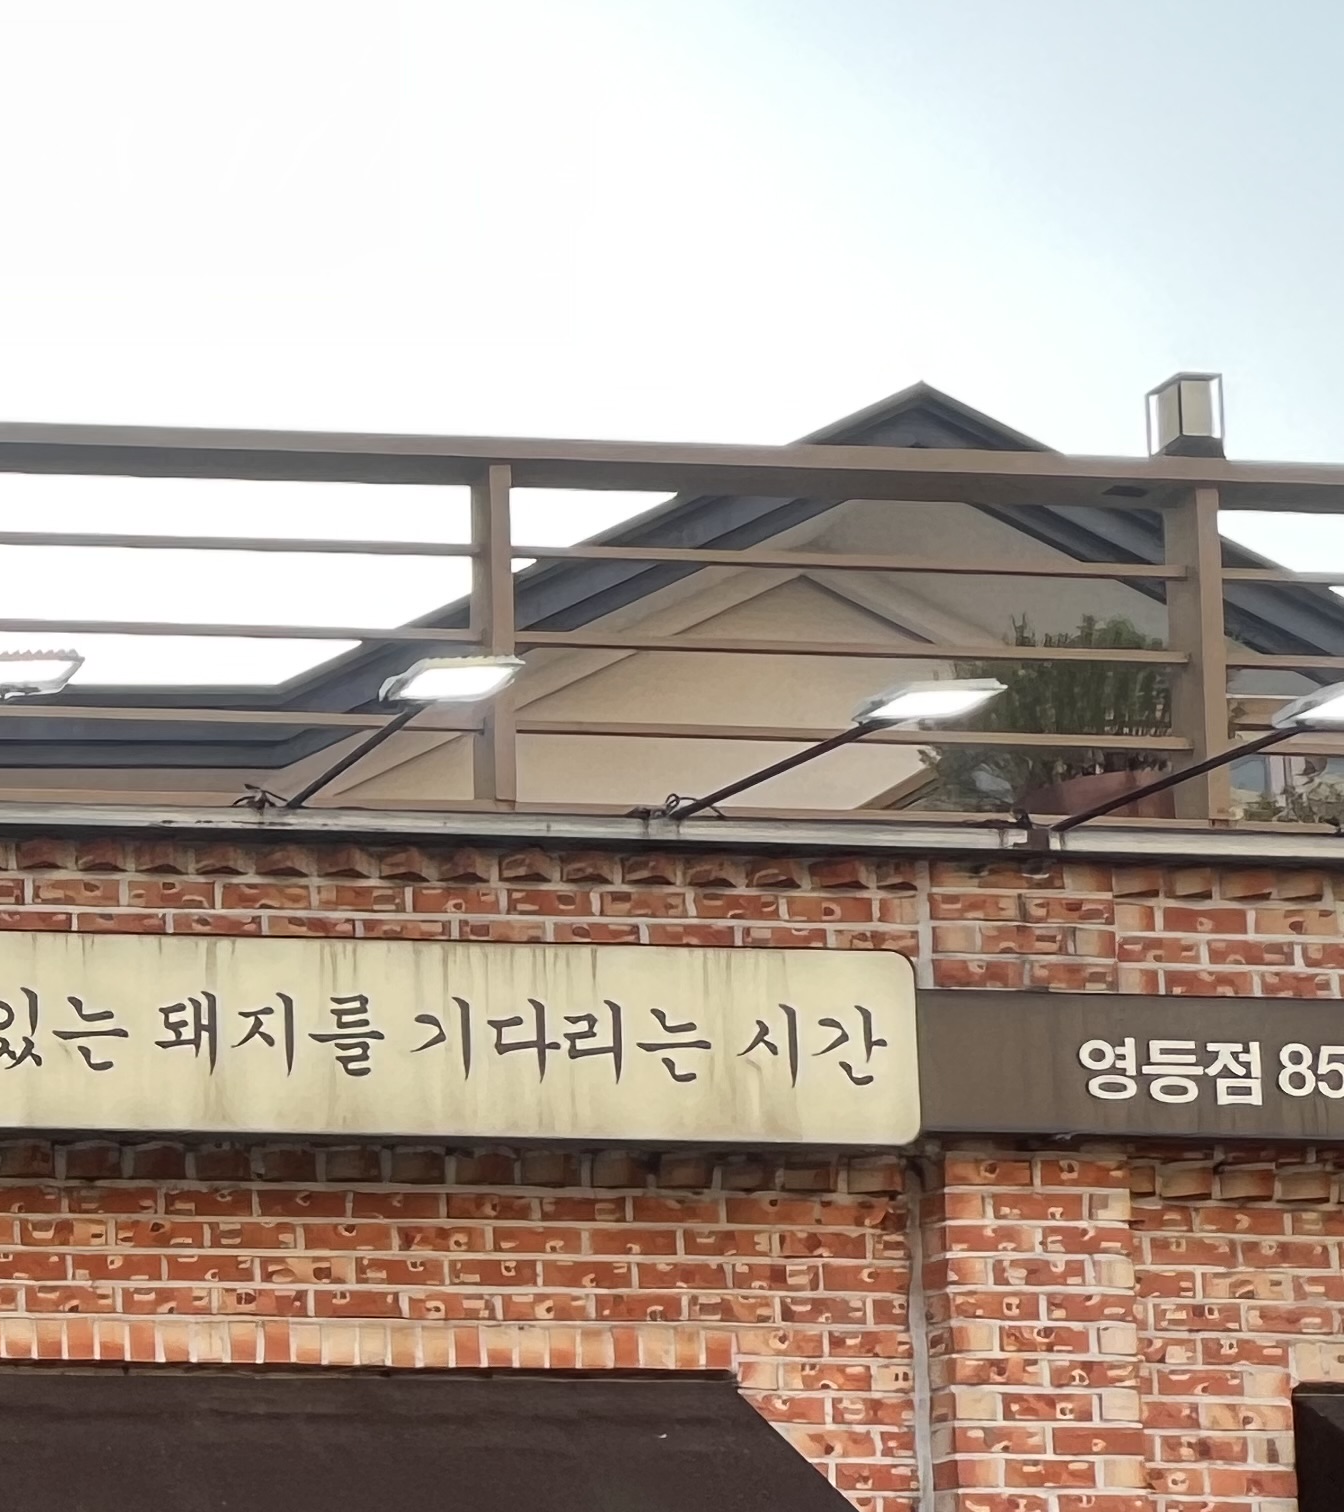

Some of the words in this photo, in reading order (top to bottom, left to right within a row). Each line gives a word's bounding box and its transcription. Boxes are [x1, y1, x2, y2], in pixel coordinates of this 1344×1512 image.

[155, 992, 386, 1078] 돼지를
[415, 996, 713, 1084] 기다리는
[741, 1004, 888, 1088] 시간
[1078, 1037, 1263, 1106] 영등점
